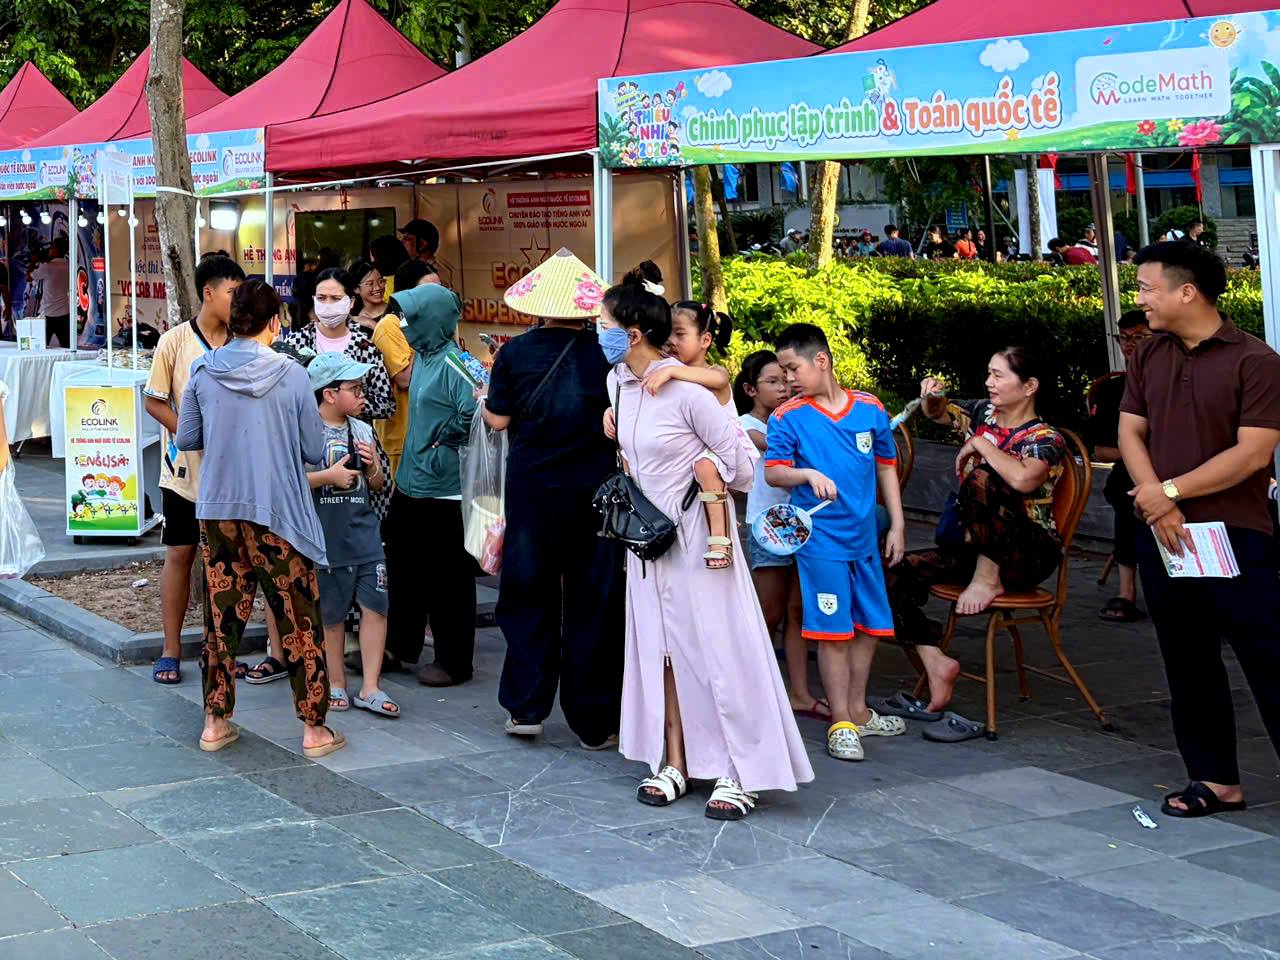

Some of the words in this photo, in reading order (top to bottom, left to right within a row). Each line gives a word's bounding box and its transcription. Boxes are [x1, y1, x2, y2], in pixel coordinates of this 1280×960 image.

[743, 108, 786, 145] phục
[791, 105, 819, 144] lập
[825, 101, 877, 134] trình
[882, 101, 899, 131] &
[905, 95, 959, 129] Toán
[967, 80, 1025, 132] quốc
[1031, 76, 1058, 122] tế
[639, 142, 668, 157] 2026
[234, 152, 263, 165] ECOLINK
[275, 280, 292, 296] TIẾN
[81, 418, 119, 426] ECOLINK
[319, 496, 344, 504] STREET
